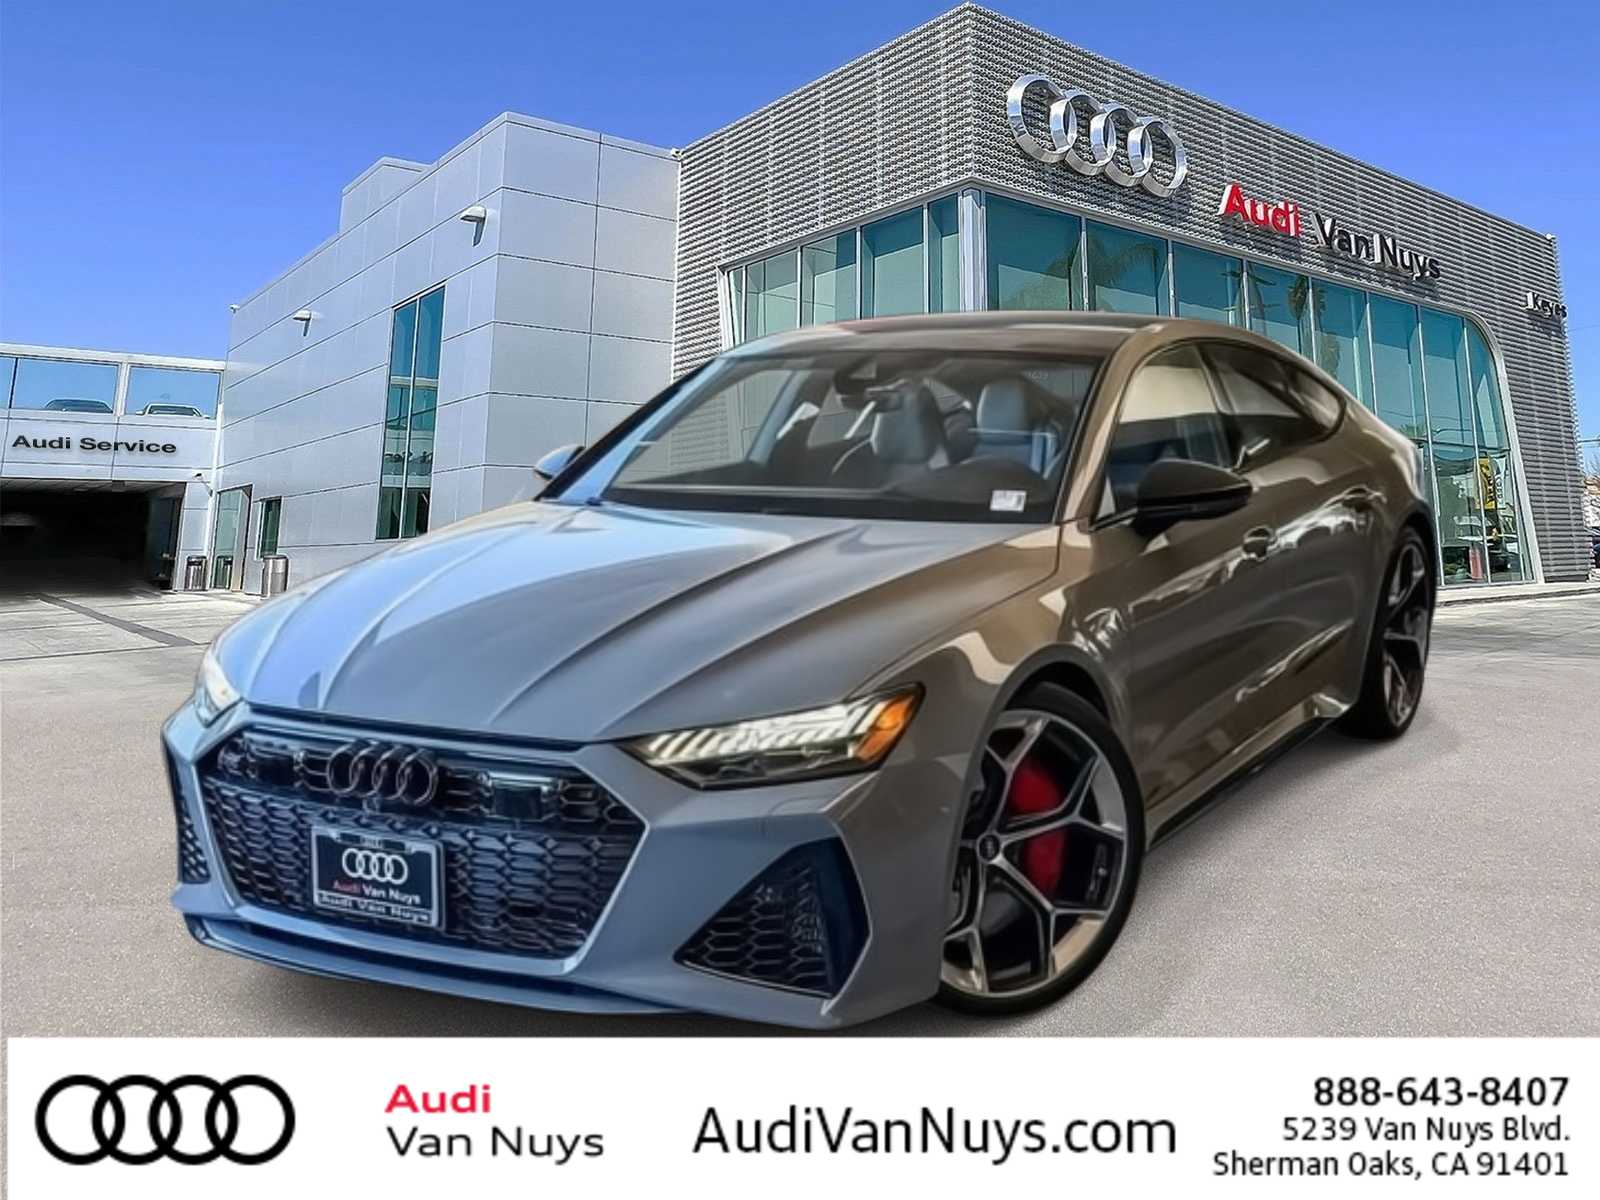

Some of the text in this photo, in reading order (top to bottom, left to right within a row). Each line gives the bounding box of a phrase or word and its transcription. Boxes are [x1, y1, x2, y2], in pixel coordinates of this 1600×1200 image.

[1219, 181, 1441, 281] Audi Van Nuys
[1526, 291, 1567, 319] Keyes
[12, 435, 177, 453] Audi Service
[332, 879, 421, 905] Audi Van Nuys
